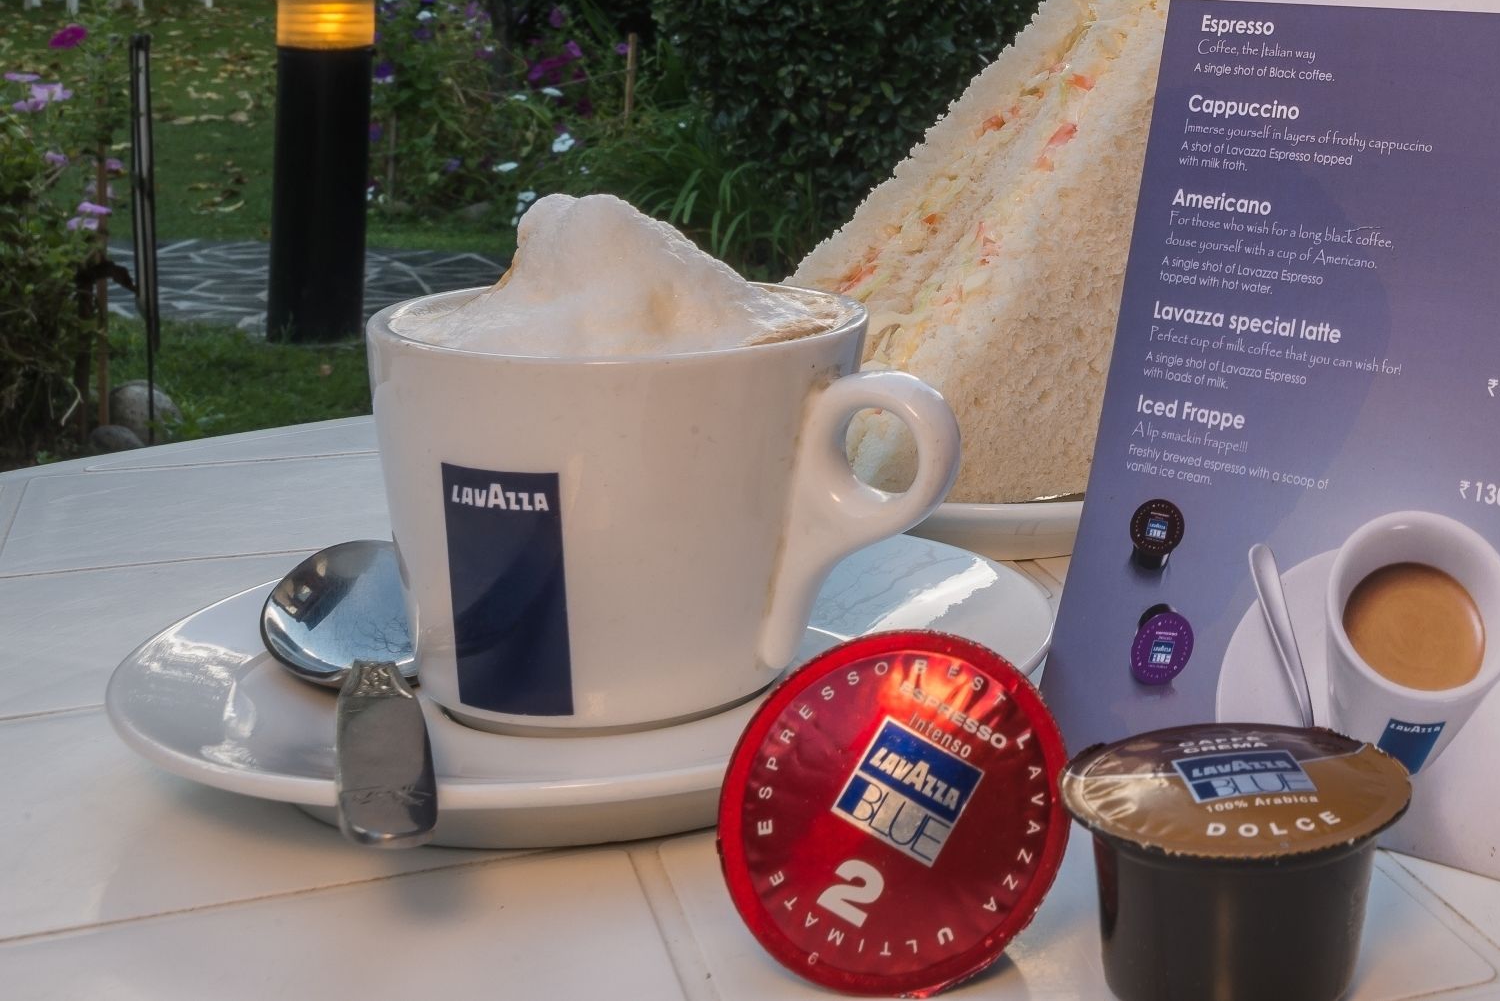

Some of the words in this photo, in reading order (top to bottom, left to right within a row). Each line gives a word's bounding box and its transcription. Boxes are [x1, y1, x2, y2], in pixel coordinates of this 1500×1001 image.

[1201, 14, 1275, 36] Espresso
[1197, 38, 1240, 56] Coffee,
[1242, 44, 1259, 56] the
[1260, 42, 1293, 58] Italian
[1295, 51, 1316, 65] way
[1194, 63, 1202, 72] A
[1204, 62, 1232, 77] single
[1233, 64, 1255, 76] shot
[1256, 66, 1268, 78] of
[1269, 67, 1296, 79] Black
[1298, 70, 1336, 82] coffee.
[1188, 94, 1300, 120] Cappuccino
[1184, 119, 1225, 135] Immerse
[1227, 124, 1272, 141] yourself
[1272, 128, 1282, 140] in
[1283, 127, 1316, 147] layers
[1318, 129, 1332, 144] of
[1332, 132, 1366, 152] frothy
[1368, 139, 1433, 156] cappuccino
[1179, 156, 1199, 167] with
[1201, 157, 1221, 169] milk
[1222, 159, 1248, 172] froth.
[1180, 141, 1189, 151] A
[1191, 141, 1212, 152] shot
[1214, 144, 1225, 155] of
[1226, 144, 1267, 158] Lavazza
[1269, 148, 1311, 163] Espresso
[1313, 152, 1353, 167] topped
[1172, 188, 1272, 216] Americano
[1169, 210, 1190, 226] For
[1191, 213, 1221, 230] those
[1223, 217, 1244, 233] who
[1246, 220, 1269, 235] wish
[1271, 221, 1288, 237] for
[1289, 230, 1297, 238] a
[1298, 224, 1322, 245] long
[1324, 226, 1353, 244] black
[1355, 232, 1395, 250] coffee,
[1165, 230, 1197, 248] douse
[1198, 239, 1243, 254] yourself
[1244, 242, 1265, 256] with
[1267, 249, 1274, 257] a
[1276, 250, 1297, 265] cup
[1300, 247, 1313, 261] of
[1313, 248, 1378, 269] Americano.
[1159, 270, 1197, 285] topped
[1198, 274, 1220, 287] with
[1221, 276, 1239, 290] hot
[1241, 279, 1273, 295] water.
[1161, 255, 1170, 266] A
[1171, 256, 1199, 272] single
[1201, 260, 1223, 272] shot
[1225, 262, 1236, 274] of
[1237, 264, 1278, 280] Lavazza
[1281, 269, 1324, 286] Espresso
[1153, 301, 1225, 328] Lavazza
[1228, 312, 1295, 338] special
[1300, 319, 1341, 344] latte
[1150, 325, 1188, 344] Perfect
[1190, 336, 1210, 353] cup
[1212, 334, 1226, 350] of
[1226, 337, 1246, 353] milk
[1247, 341, 1283, 357] coffee
[1285, 345, 1307, 362] that
[1309, 354, 1330, 368] you
[1332, 357, 1352, 368] can
[1355, 356, 1379, 373] wish
[1381, 359, 1402, 376] for!
[1143, 366, 1164, 380] with
[1165, 368, 1192, 384] loads
[1194, 373, 1205, 385] of
[1206, 375, 1229, 390] milk.
[1145, 351, 1153, 362] A
[1155, 352, 1183, 368] single
[1185, 355, 1206, 369] shot
[1208, 359, 1222, 372] of
[1221, 361, 1262, 378] Lavazza
[1264, 368, 1307, 385] Espresso
[1137, 394, 1178, 419] Iced
[1182, 401, 1246, 431] Frappe
[1131, 421, 1144, 438] A
[1146, 422, 1160, 442] lip
[1161, 428, 1202, 445] smackin
[1203, 431, 1249, 456] frappe!!!
[1126, 461, 1157, 475] vanilla
[1159, 465, 1175, 478] ice
[1177, 471, 1213, 486] cream.
[1128, 443, 1161, 461] Freshly
[1162, 449, 1202, 467] brewed
[1203, 458, 1246, 477] espresso
[1248, 464, 1270, 480] with
[1272, 471, 1280, 481] a
[1281, 471, 1315, 490] scoop
[1317, 479, 1330, 490] of
[451, 482, 550, 512] LAVAZZA
[899, 681, 1007, 750] ESPRESSO
[1389, 723, 1441, 734] LAVAZZA
[756, 661, 889, 837] ESPRESSO
[869, 746, 961, 810] LAVAZZA
[1192, 760, 1292, 778] LAVAZZA
[1209, 772, 1317, 796] BLUE
[1205, 800, 1249, 813] 100%
[1254, 795, 1319, 807] Arabica
[850, 782, 951, 865] BLUE
[982, 732, 1045, 913] LAVAZZA
[1206, 810, 1341, 838] DOLCE
[816, 859, 885, 928] 2
[769, 870, 955, 956] ULTIMATE
